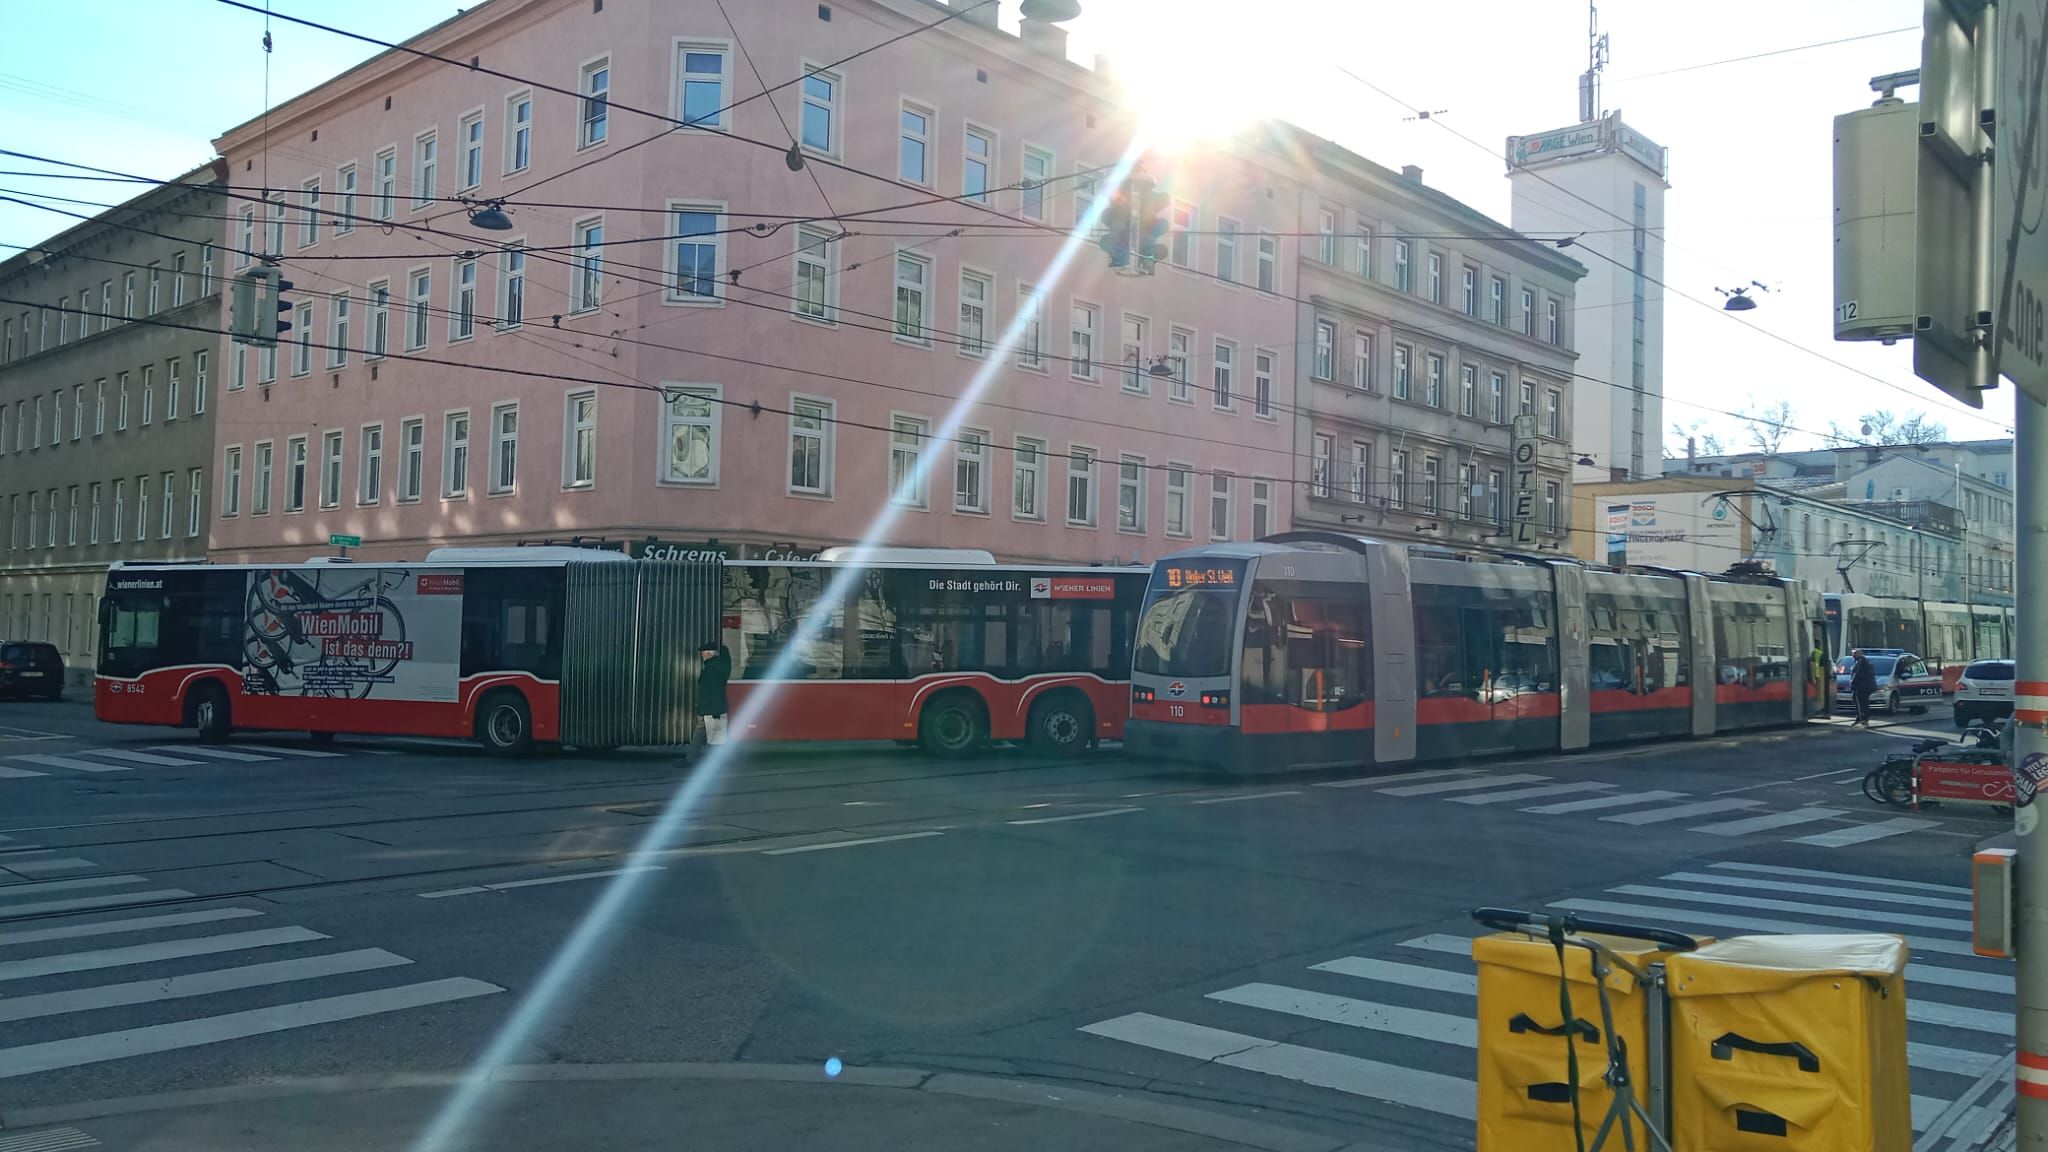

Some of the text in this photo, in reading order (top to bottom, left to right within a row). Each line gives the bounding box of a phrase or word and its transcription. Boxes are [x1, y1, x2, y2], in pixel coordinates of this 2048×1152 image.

[1840, 302, 1857, 320] 12
[1515, 416, 1534, 543] HOTEL
[643, 544, 727, 561] Schrems
[1167, 569, 1182, 587] 10
[1283, 565, 1296, 577] 110
[117, 579, 164, 590] wienerlinien.at
[929, 579, 1022, 592] Die Stadt gehört Dir.
[1086, 585, 1111, 593] LINIEN
[301, 614, 379, 635] WienMobil
[325, 639, 409, 659] ist das denn?!
[127, 684, 145, 694] 8542
[1169, 705, 1185, 717] 110
